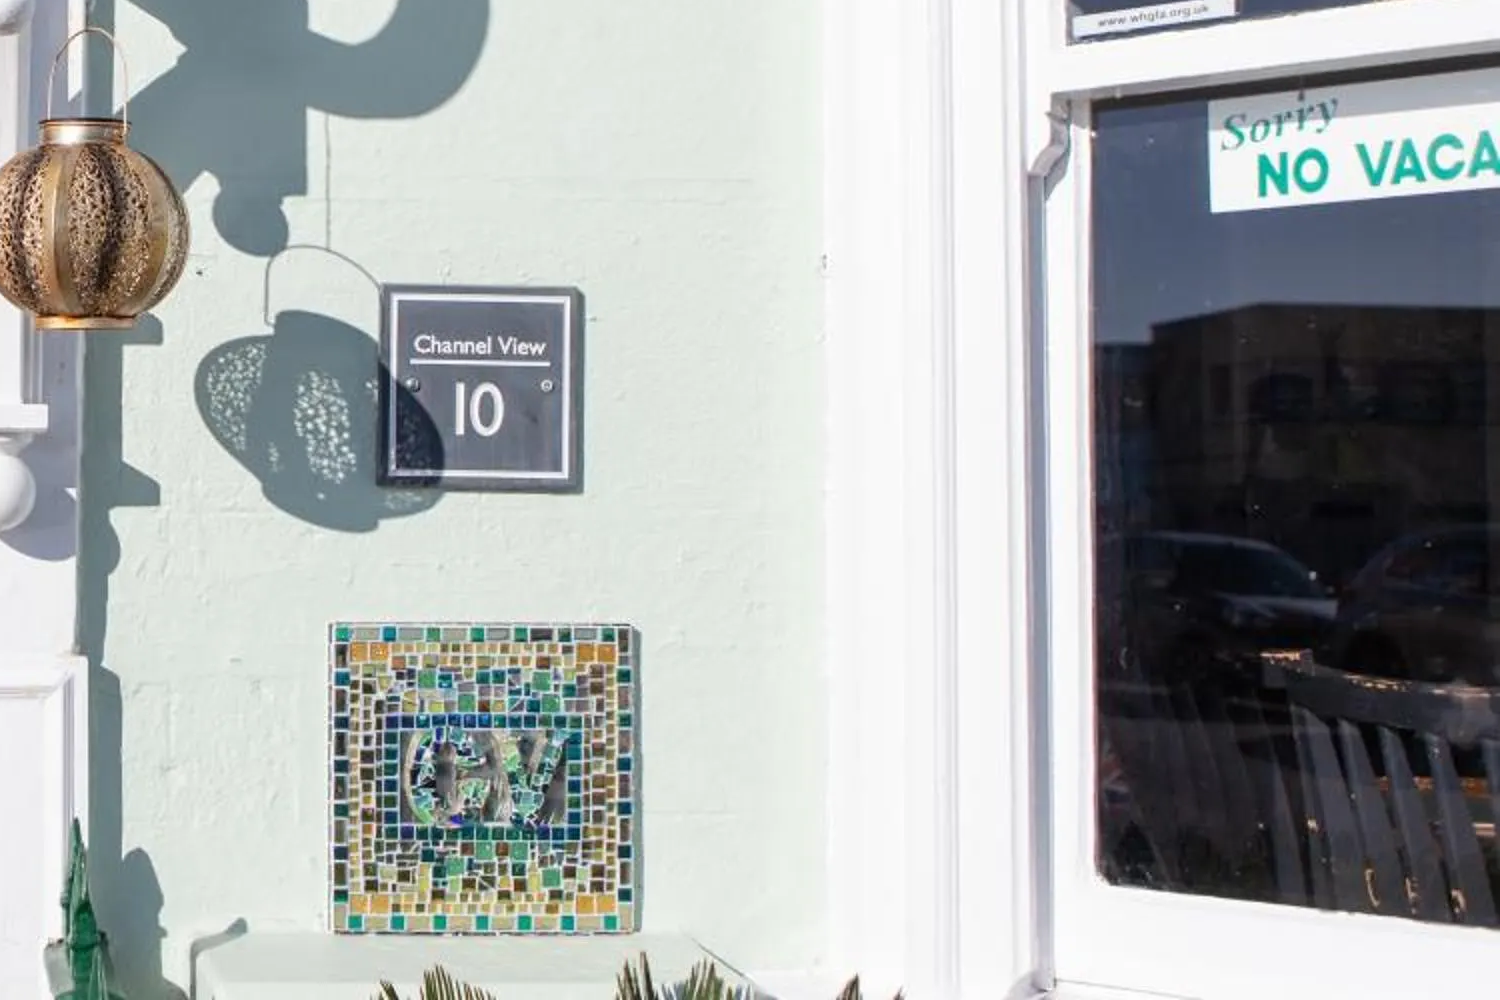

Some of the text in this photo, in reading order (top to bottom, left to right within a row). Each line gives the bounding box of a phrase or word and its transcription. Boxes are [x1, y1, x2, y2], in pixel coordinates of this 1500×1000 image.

[1220, 97, 1339, 151] Sorry
[1258, 130, 1500, 197] NO VACA
[413, 334, 547, 356] Channel View
[455, 381, 504, 437] 10
